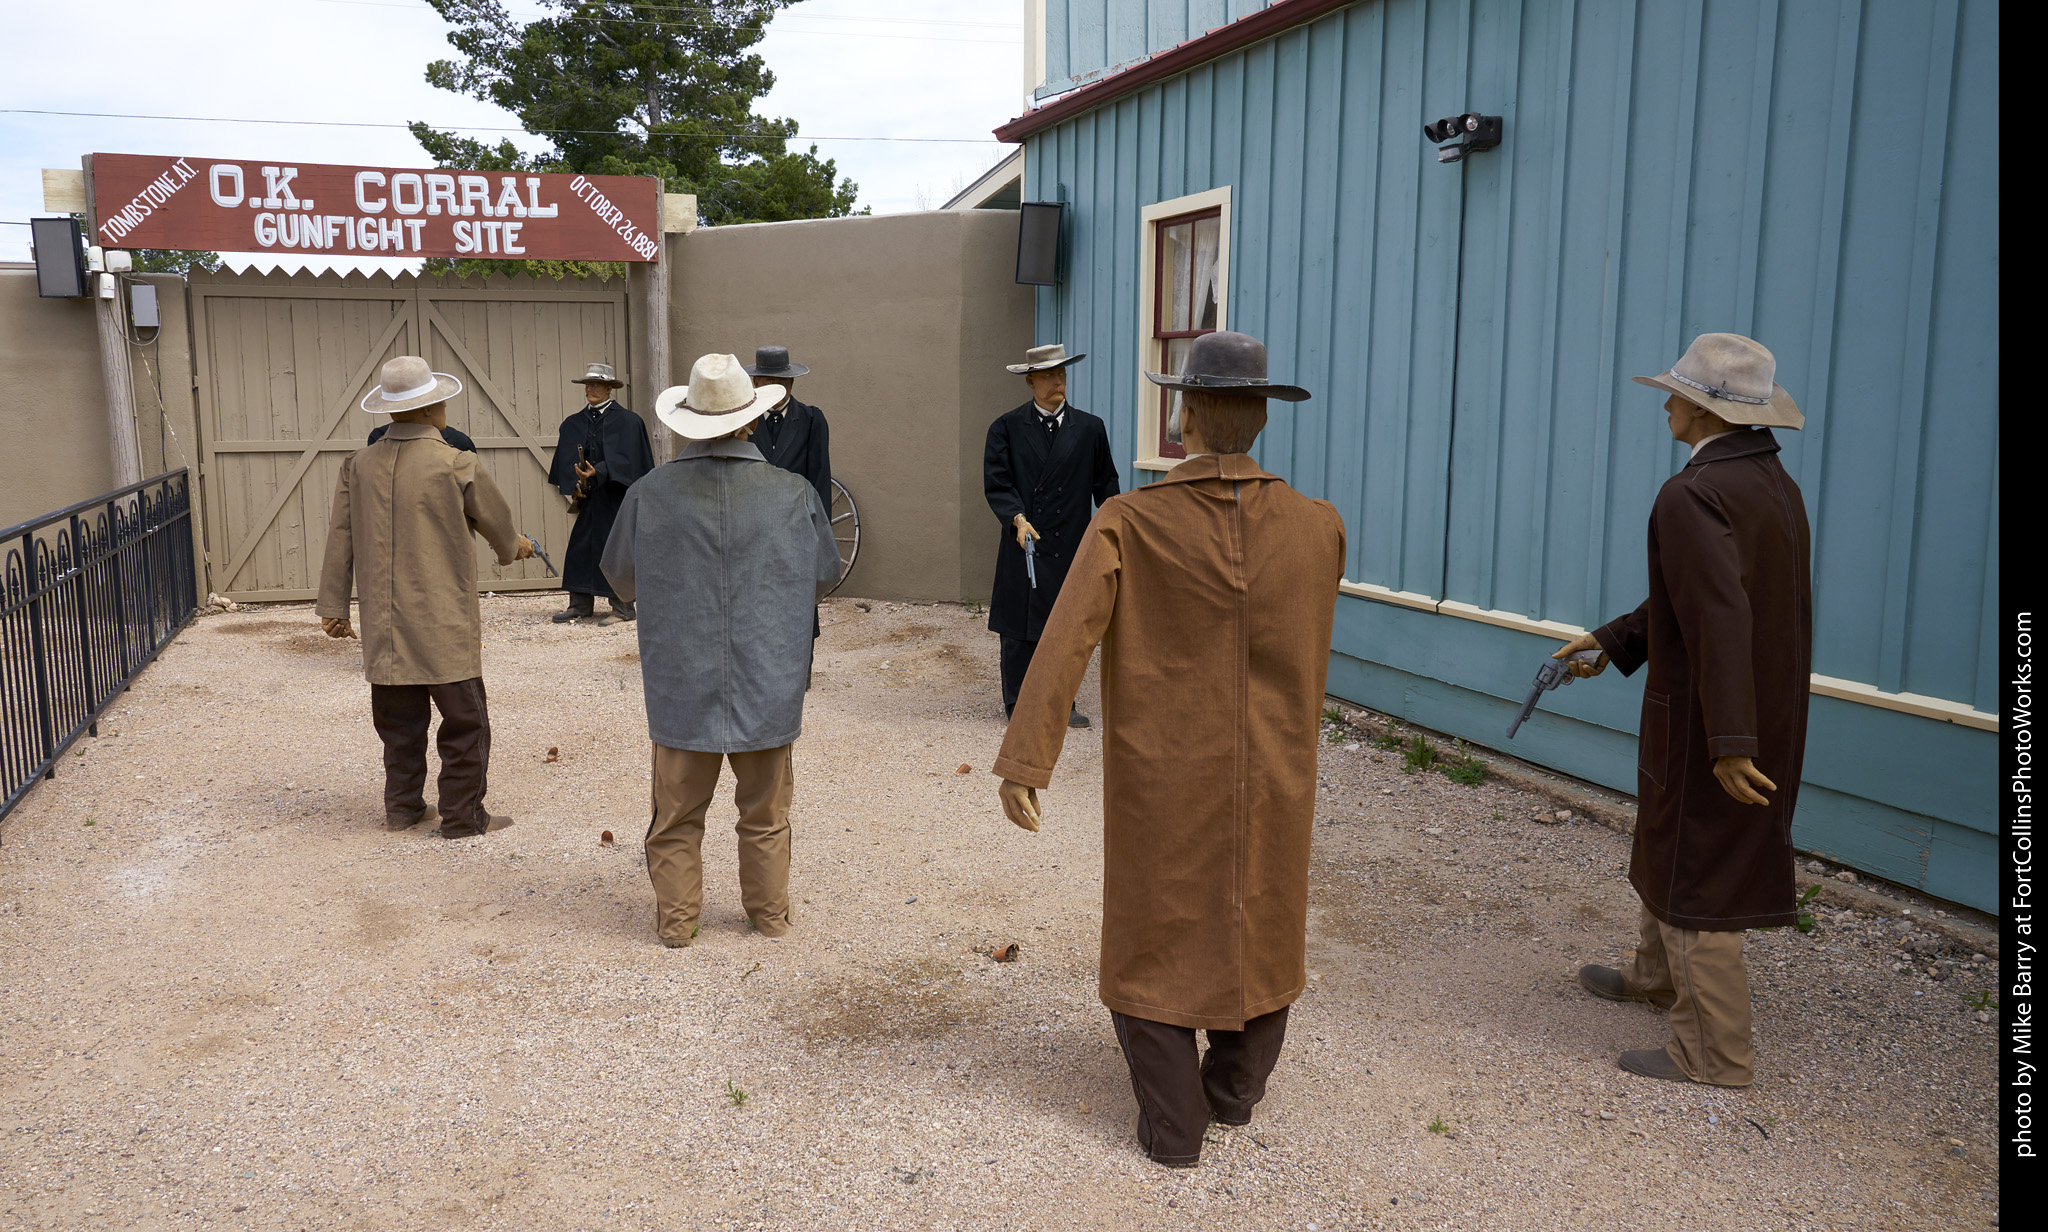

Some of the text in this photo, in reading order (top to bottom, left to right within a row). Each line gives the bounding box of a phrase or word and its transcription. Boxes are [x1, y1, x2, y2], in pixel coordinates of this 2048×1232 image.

[209, 163, 559, 219] O.K. CORRAL
[569, 175, 624, 230] OCTOBER
[253, 212, 526, 255] GUNFIGHT SITE
